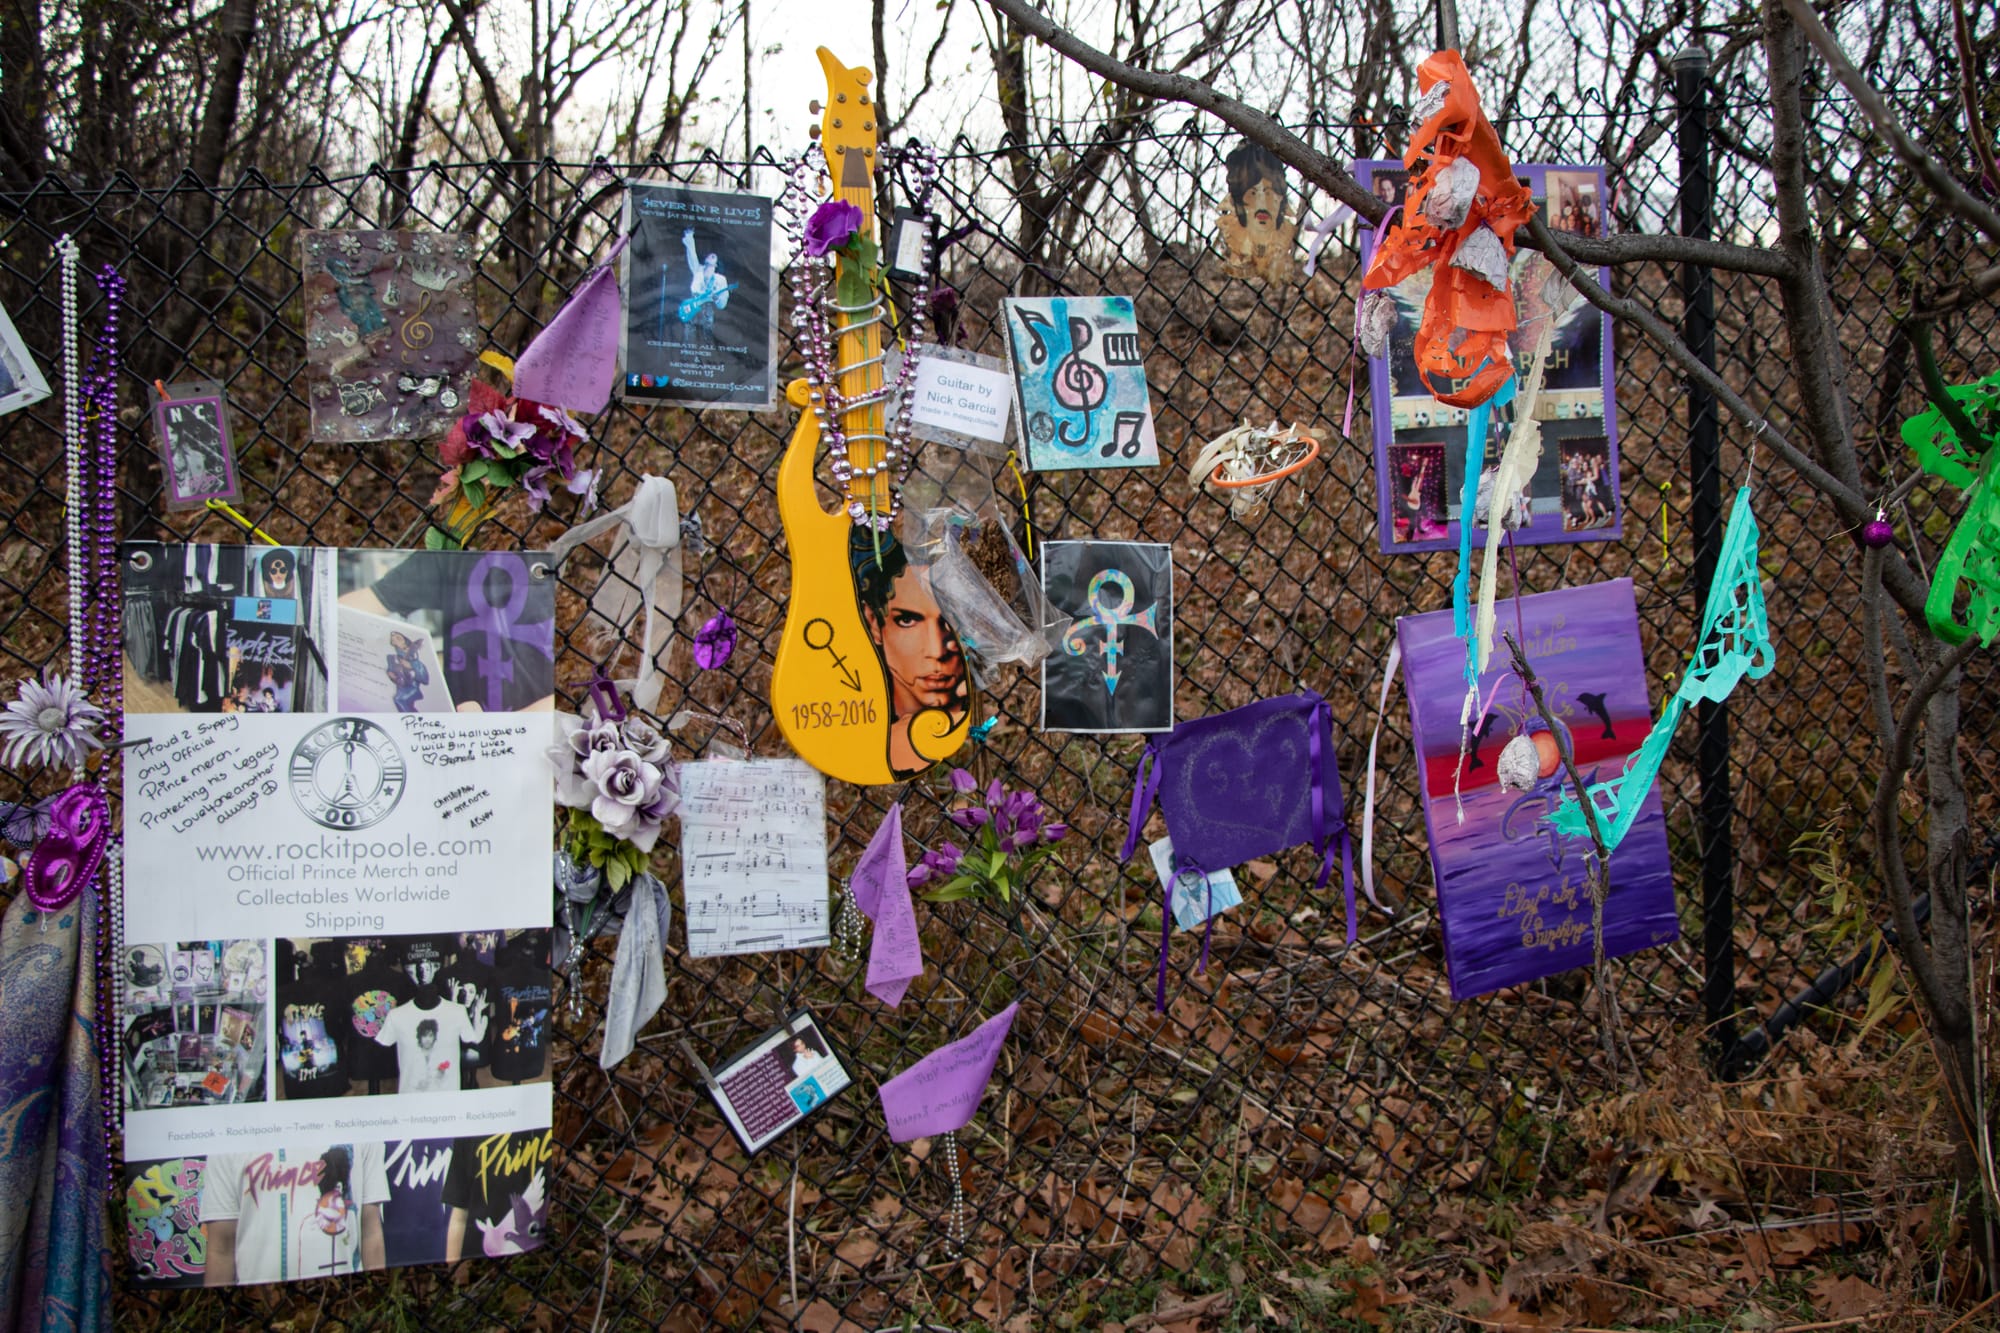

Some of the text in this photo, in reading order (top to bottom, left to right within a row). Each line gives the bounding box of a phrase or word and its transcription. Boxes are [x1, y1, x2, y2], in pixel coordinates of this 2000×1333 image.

[690, 204, 707, 213] IN
[710, 206, 720, 214] R
[724, 207, 761, 220] LIVES
[937, 375, 992, 398] Guitar by
[927, 391, 997, 416] Nick Garcia
[792, 698, 876, 730] 1958-2016
[132, 715, 239, 760] Proud 2 Supply
[172, 736, 215, 762] Official
[297, 720, 370, 763] ROCK
[138, 775, 189, 800] Prince
[139, 786, 210, 830] Protecting
[196, 834, 492, 864] www.rockitpoole.com
[227, 860, 458, 882] Official Prince Merch and
[236, 884, 451, 906] Collectables Worldwide
[305, 912, 385, 931] Shipping
[168, 1130, 216, 1141] Facebook
[226, 1125, 282, 1137] Rockitpoole
[466, 1109, 517, 1121] Rockitpoole
[243, 1152, 327, 1215] Prince
